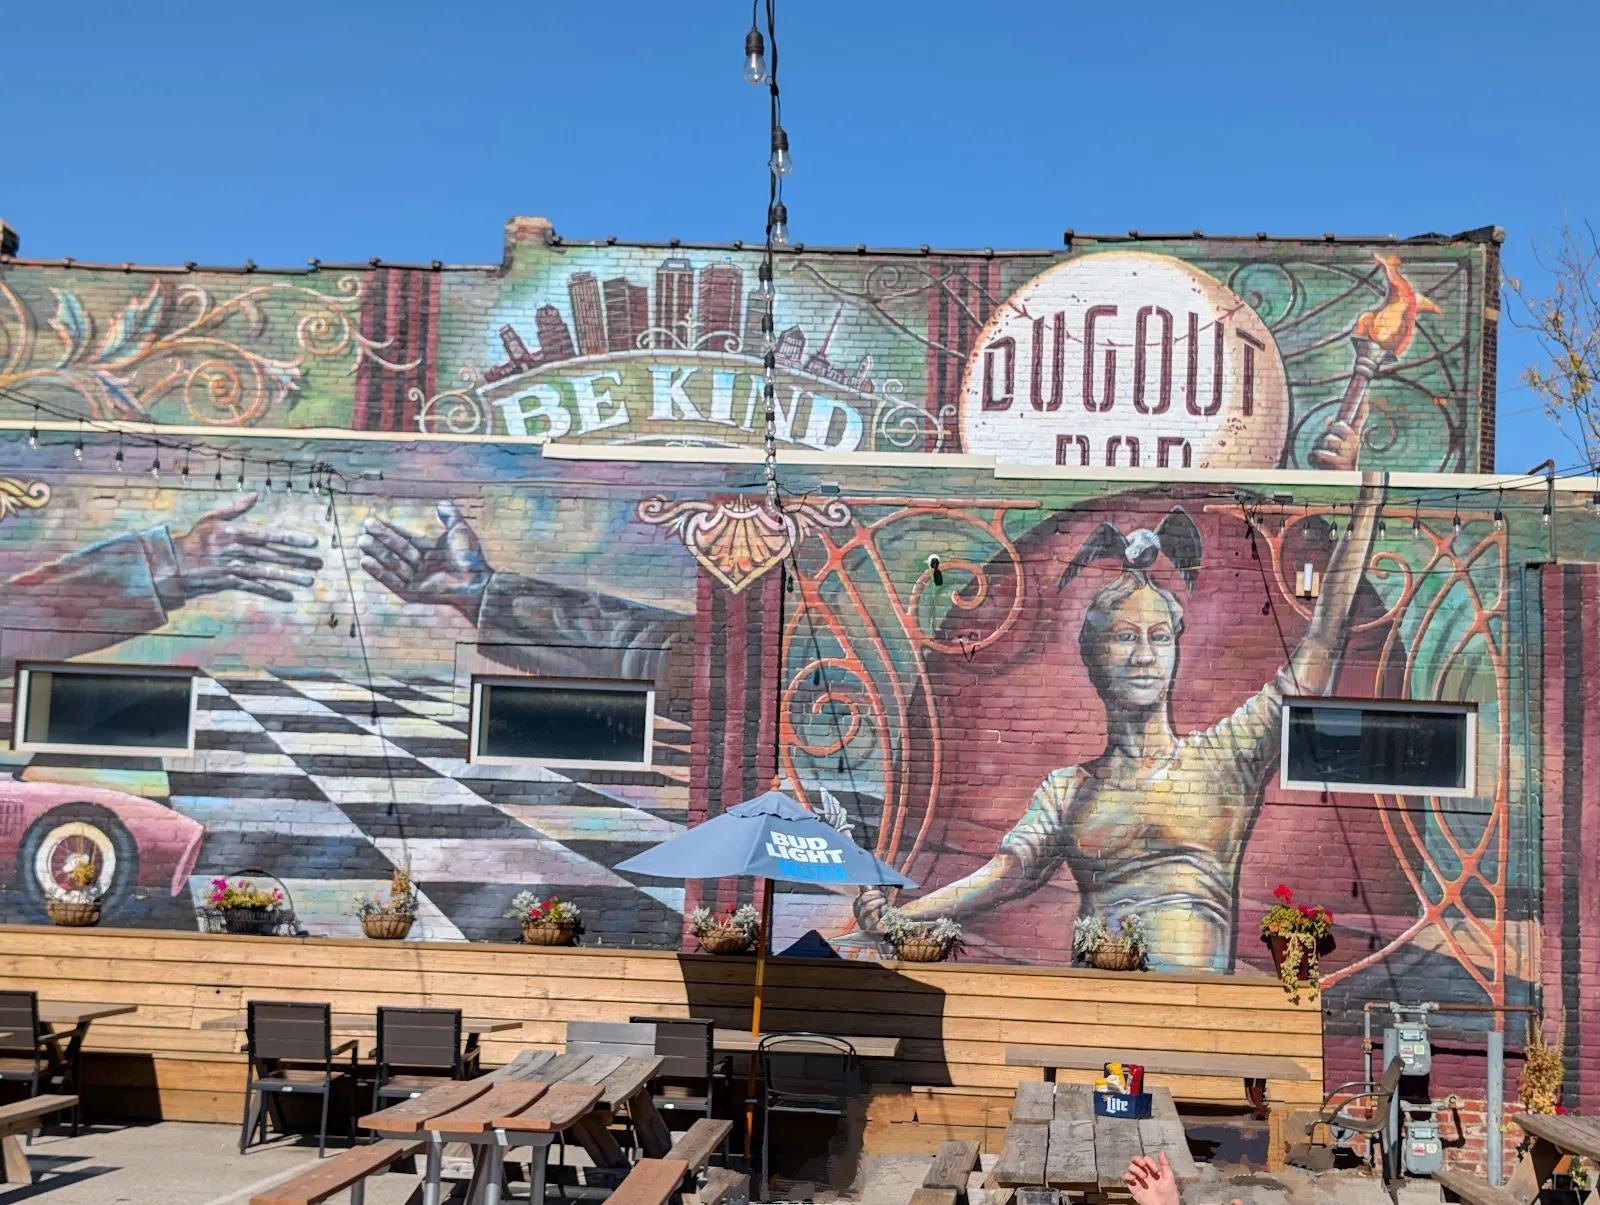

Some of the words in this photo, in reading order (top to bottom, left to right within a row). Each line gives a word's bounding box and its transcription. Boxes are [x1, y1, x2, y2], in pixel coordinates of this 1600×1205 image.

[981, 304, 1265, 417] DUGOUT
[492, 369, 630, 437] BE
[646, 365, 864, 452] KIND
[770, 831, 828, 850] BUD
[765, 842, 844, 864] LIGHT
[1106, 1097, 1128, 1113] Lite
